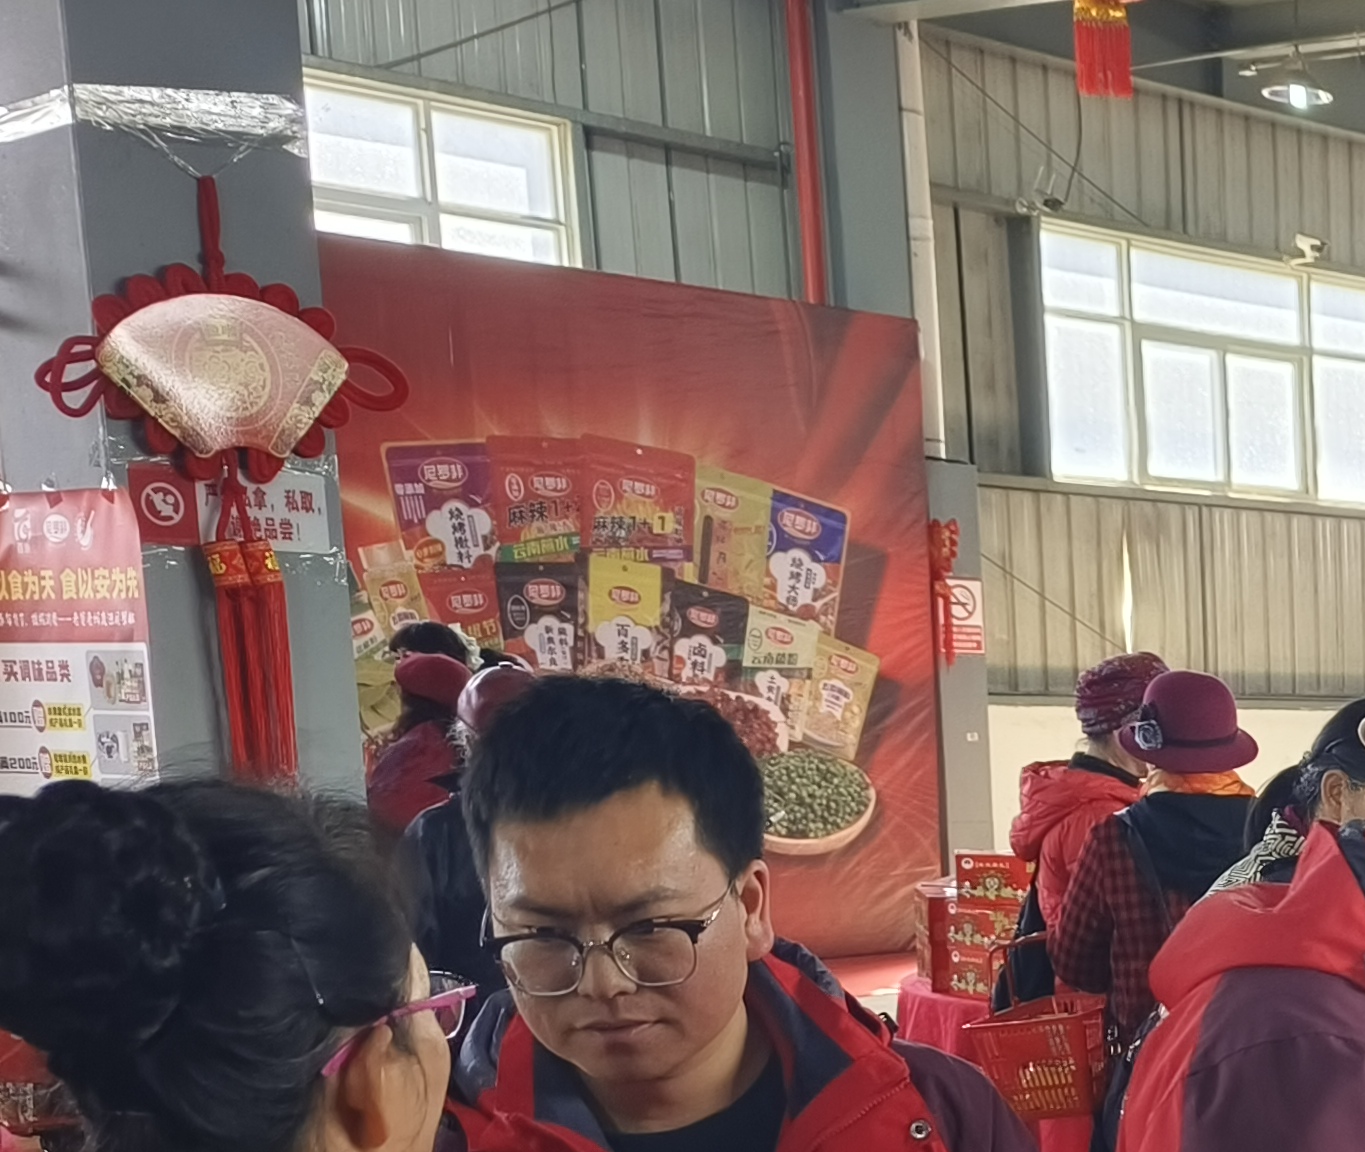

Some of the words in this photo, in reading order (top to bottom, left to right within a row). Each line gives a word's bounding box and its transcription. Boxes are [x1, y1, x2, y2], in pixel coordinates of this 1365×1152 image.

[60, 566, 139, 600] 食以安为先
[2, 659, 72, 683] 买调味品类
[0, 710, 32, 724] 100元
